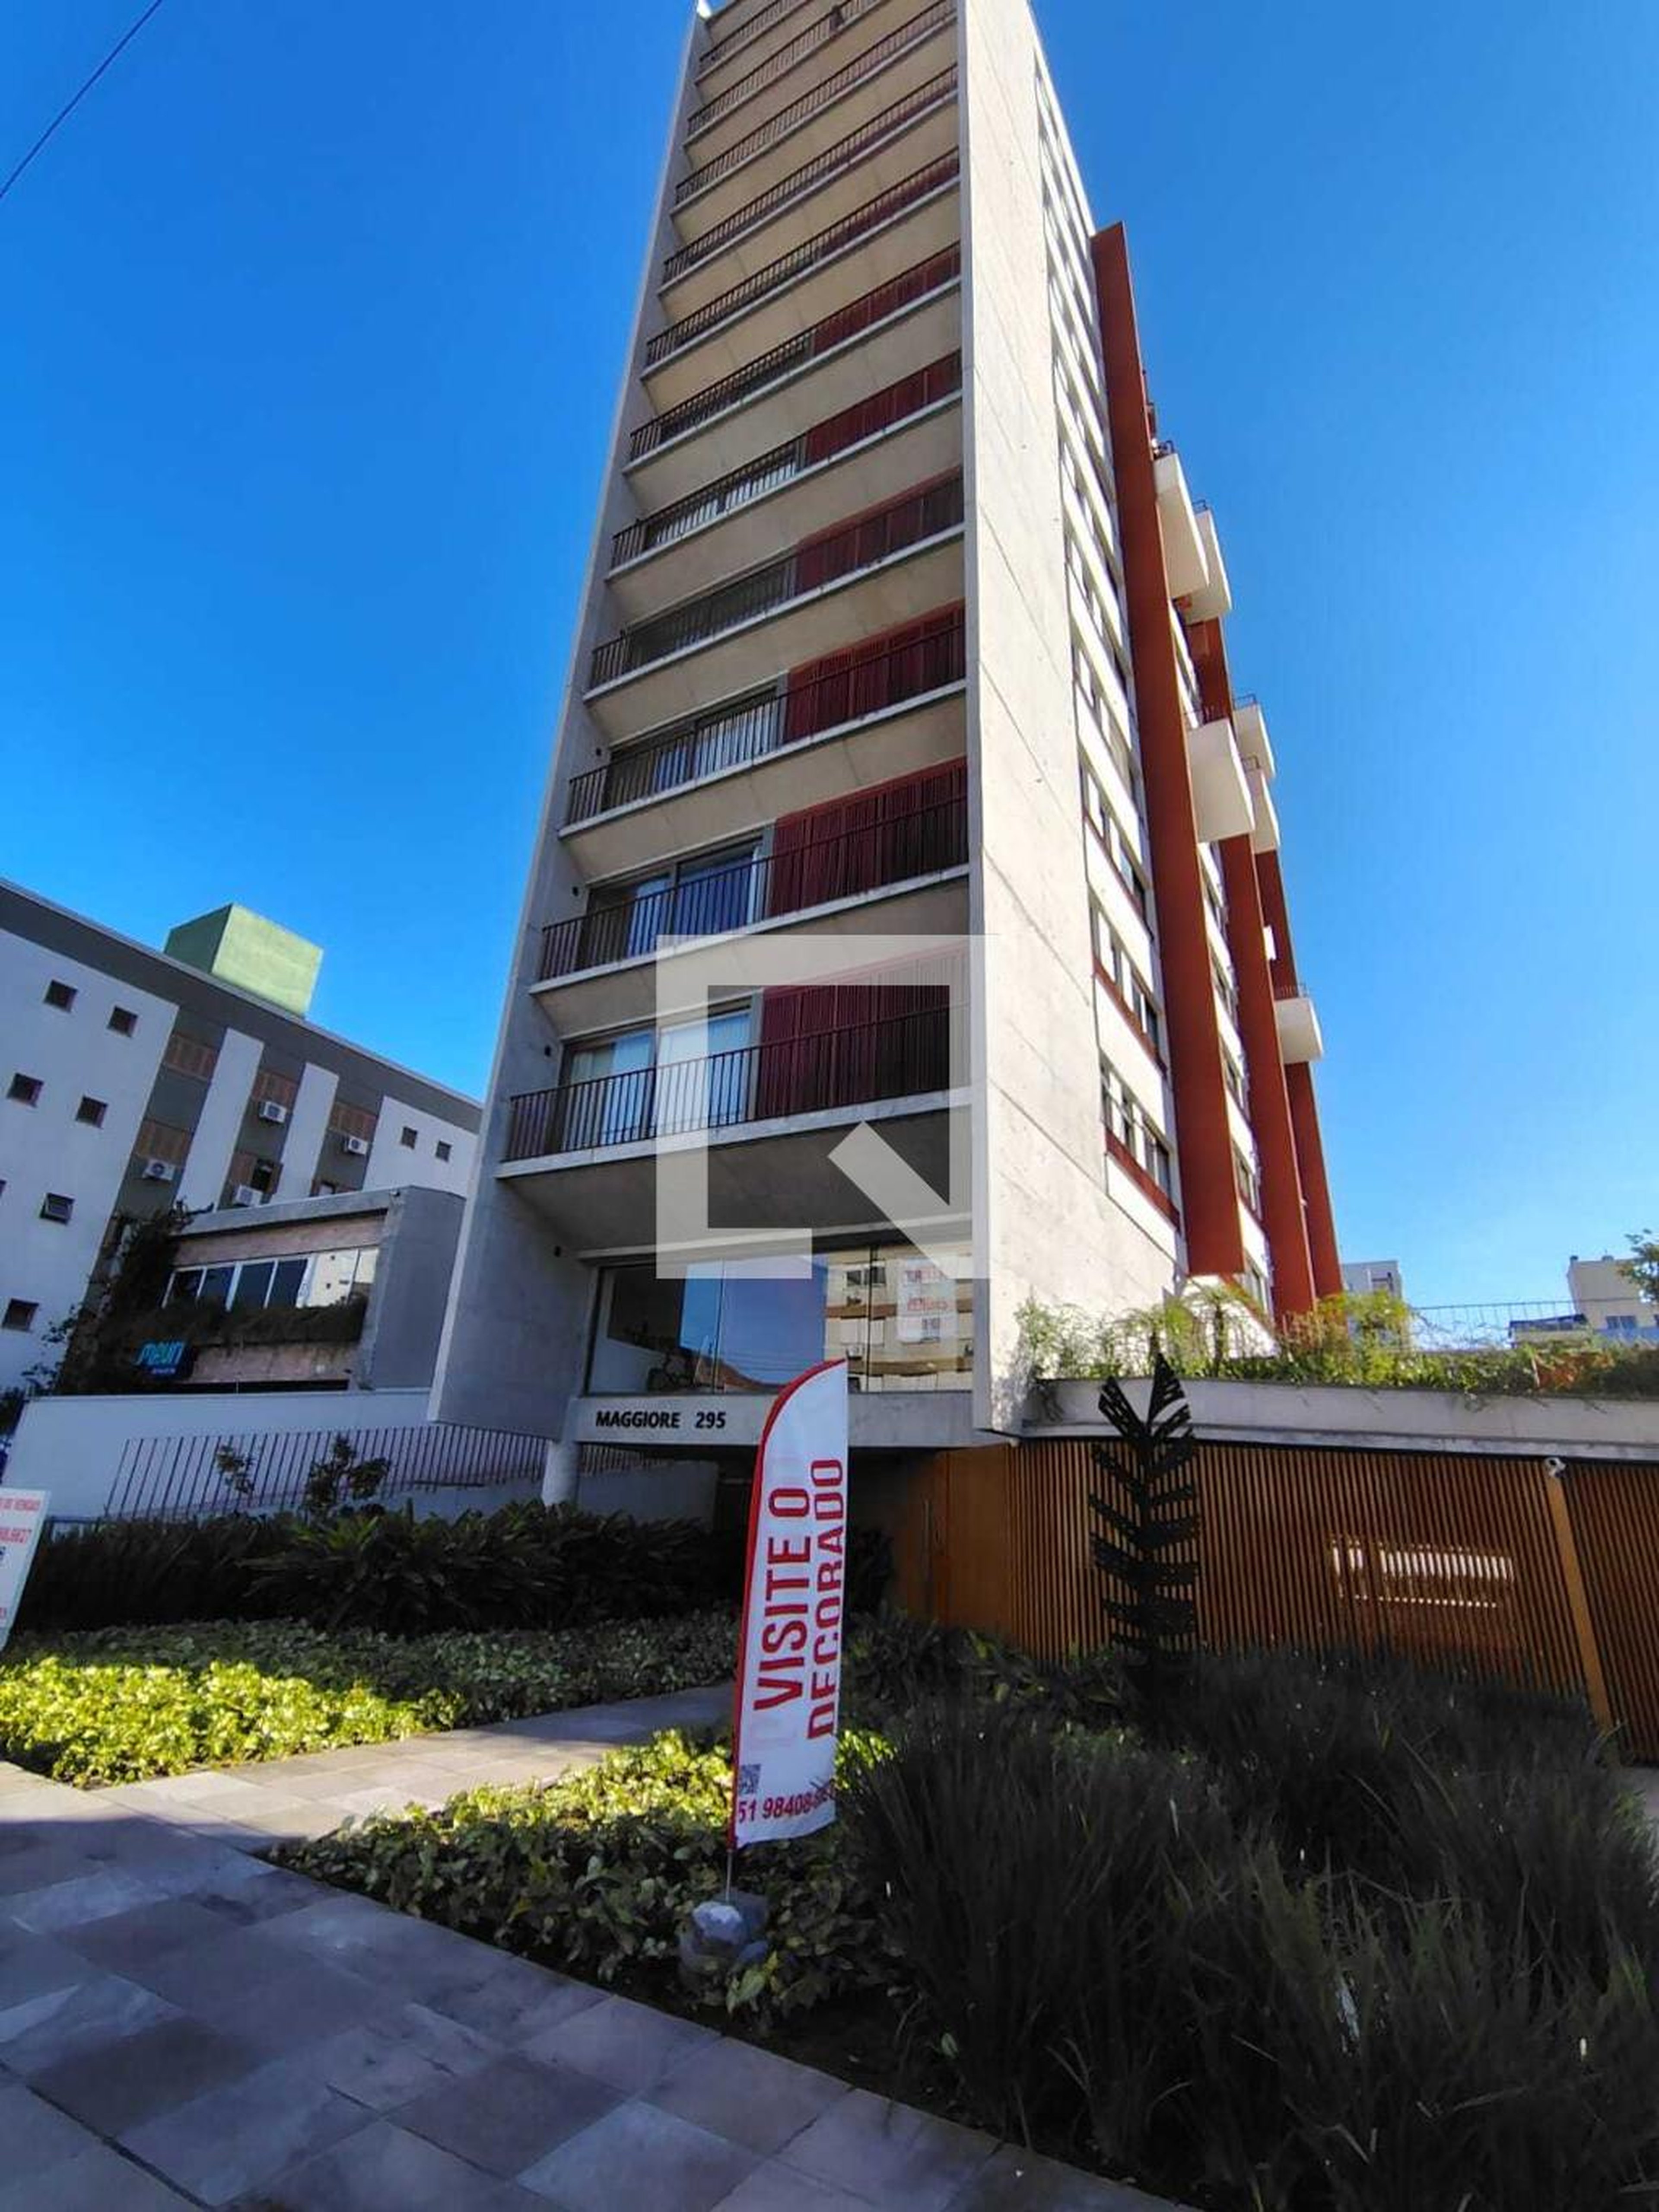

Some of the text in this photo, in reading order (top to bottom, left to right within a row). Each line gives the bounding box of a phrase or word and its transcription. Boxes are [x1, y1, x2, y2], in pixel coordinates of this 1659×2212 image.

[596, 1411, 726, 1429] MAGGIORE 295
[753, 1488, 811, 1711] VISITE O
[807, 1459, 843, 1739] DECORADO
[738, 1799, 756, 1824] 51
